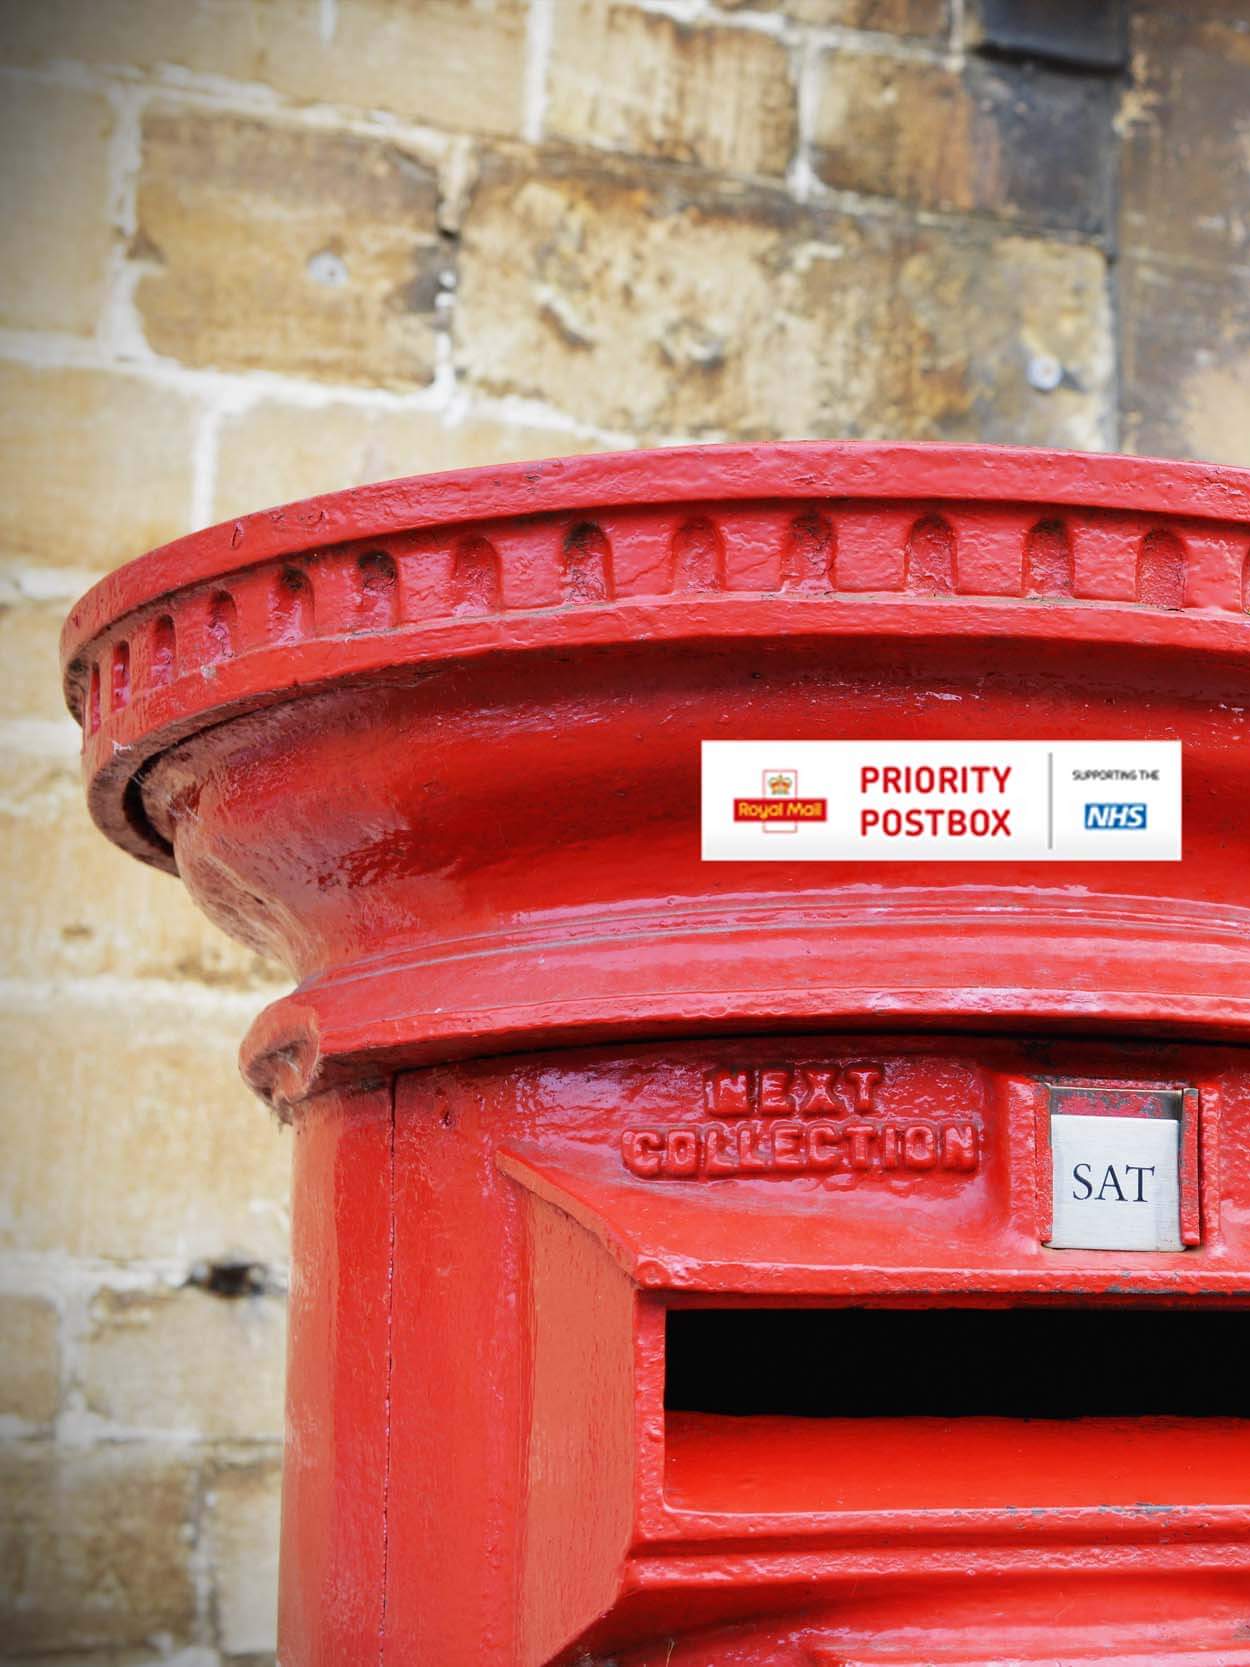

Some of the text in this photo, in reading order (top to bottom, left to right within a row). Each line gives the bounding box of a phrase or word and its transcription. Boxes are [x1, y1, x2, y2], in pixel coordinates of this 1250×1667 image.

[860, 766, 1012, 794] PRIORITY
[1072, 769, 1160, 781] SUPPORTING THE
[738, 802, 822, 819] Royal Mail
[860, 809, 1012, 837] POSTBOX
[1086, 805, 1146, 829] NHS
[706, 1063, 884, 1118] NEXT
[621, 1119, 980, 1179] COLLECTION
[1072, 1162, 1156, 1203] SAT
